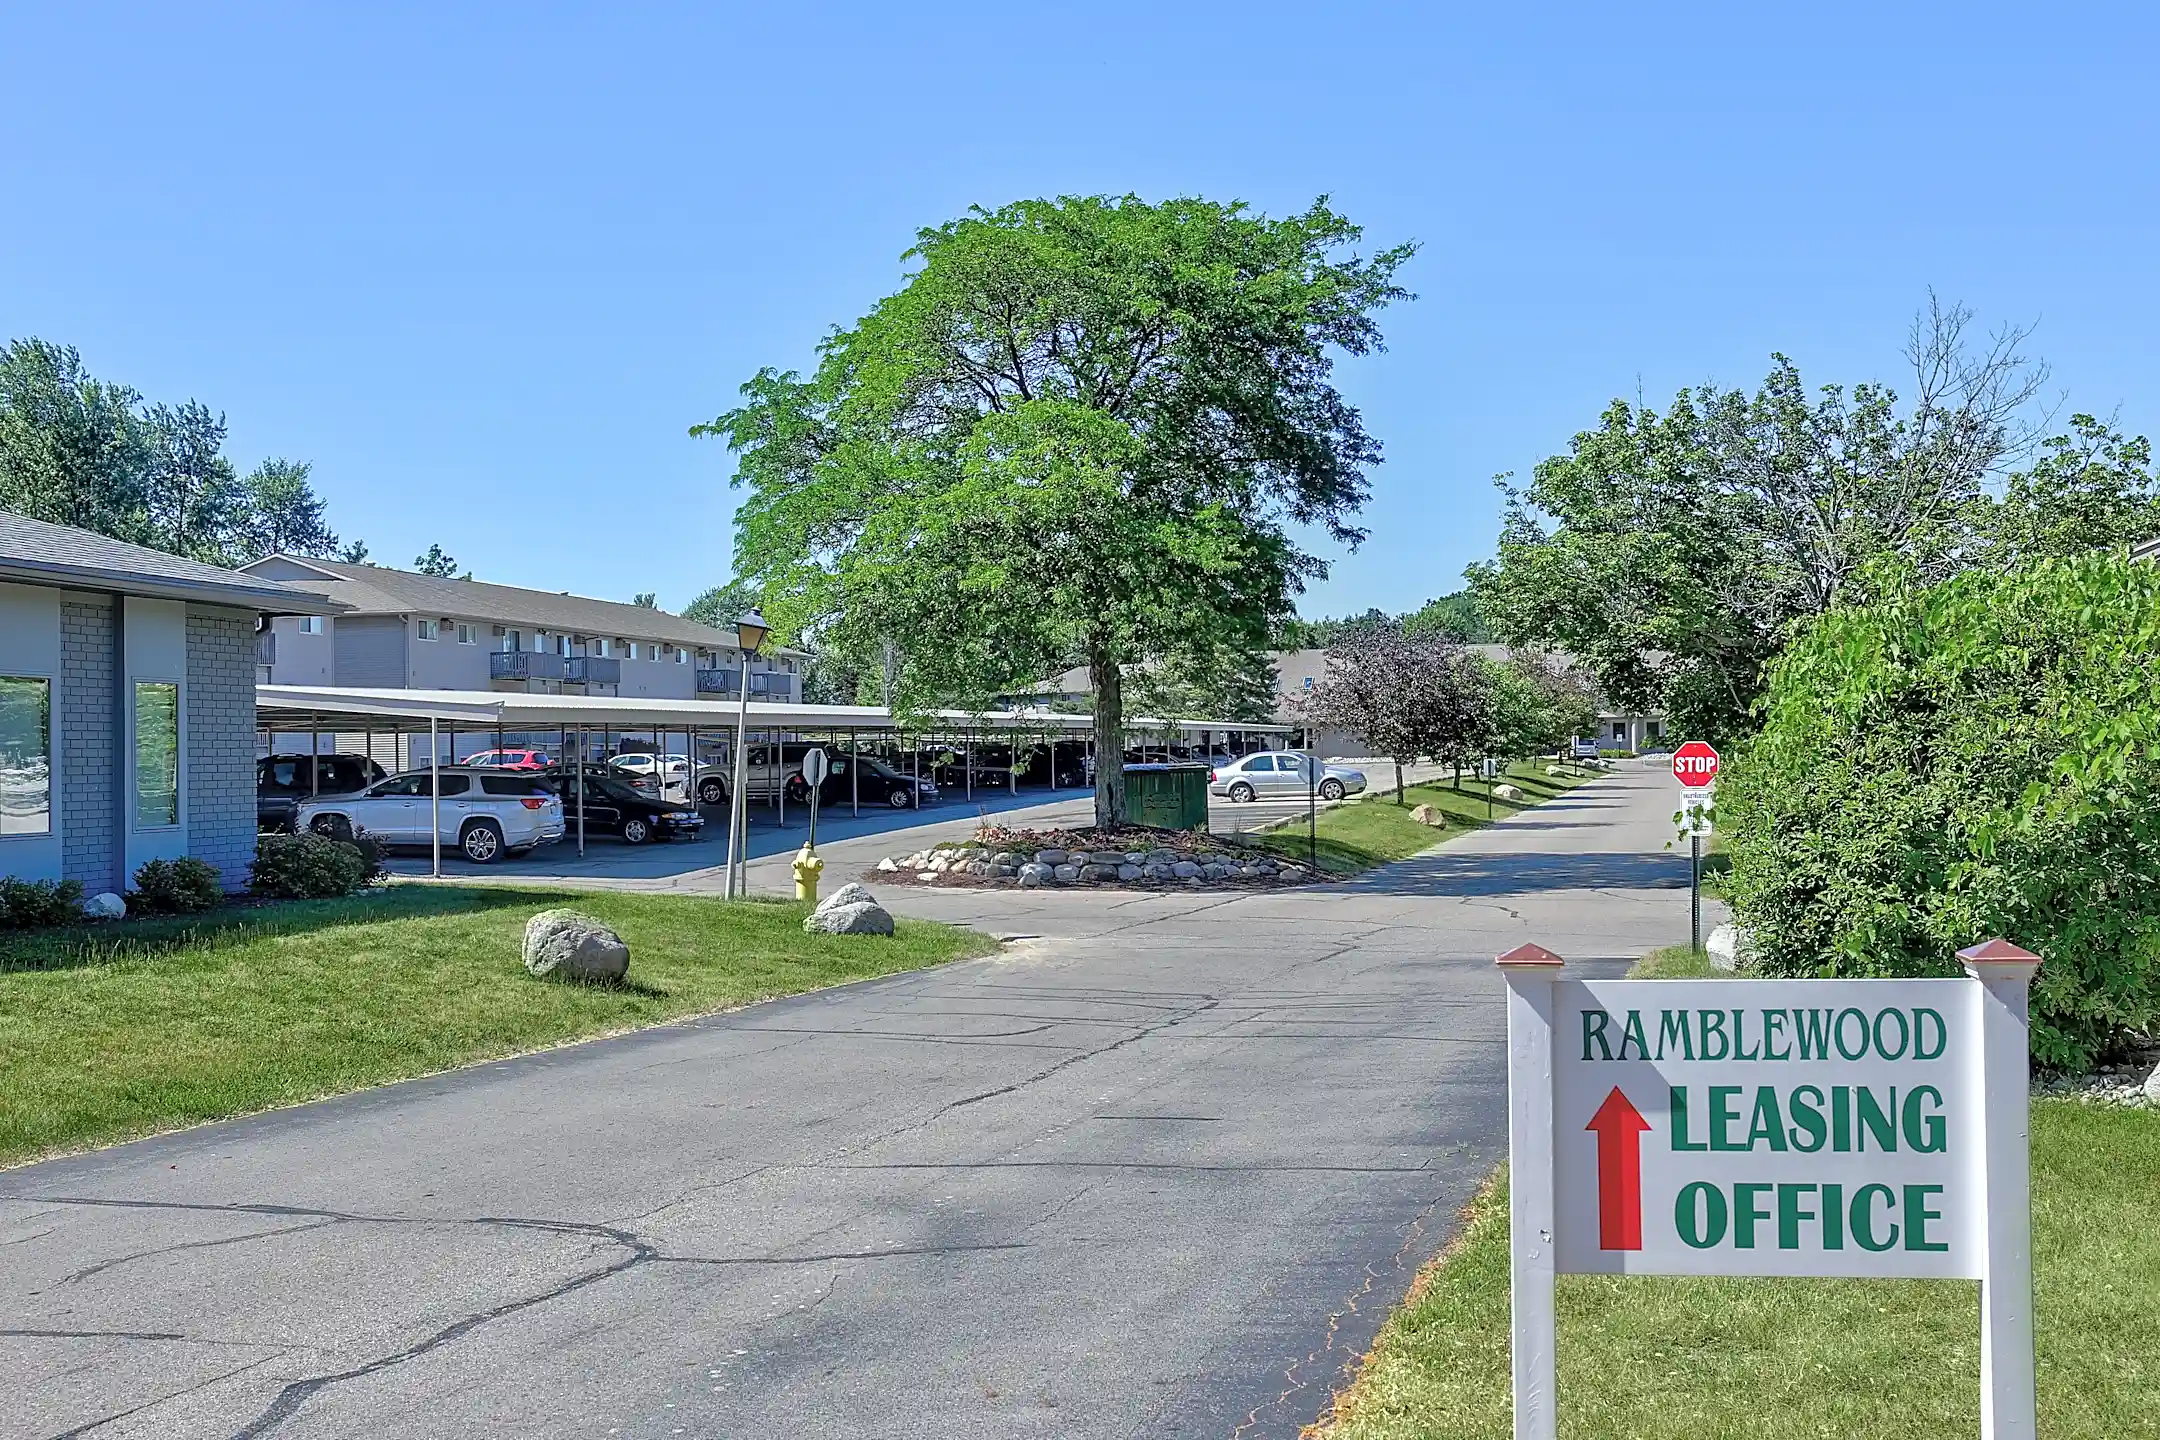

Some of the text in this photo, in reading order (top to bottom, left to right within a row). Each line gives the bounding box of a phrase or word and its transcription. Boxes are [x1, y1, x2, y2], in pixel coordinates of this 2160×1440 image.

[1675, 756, 1716, 773] STOP
[1580, 1008, 1947, 1061] RAMBLEWOOD
[1670, 1085, 1947, 1153] LEASING
[1674, 1181, 1948, 1252] OFFICE
